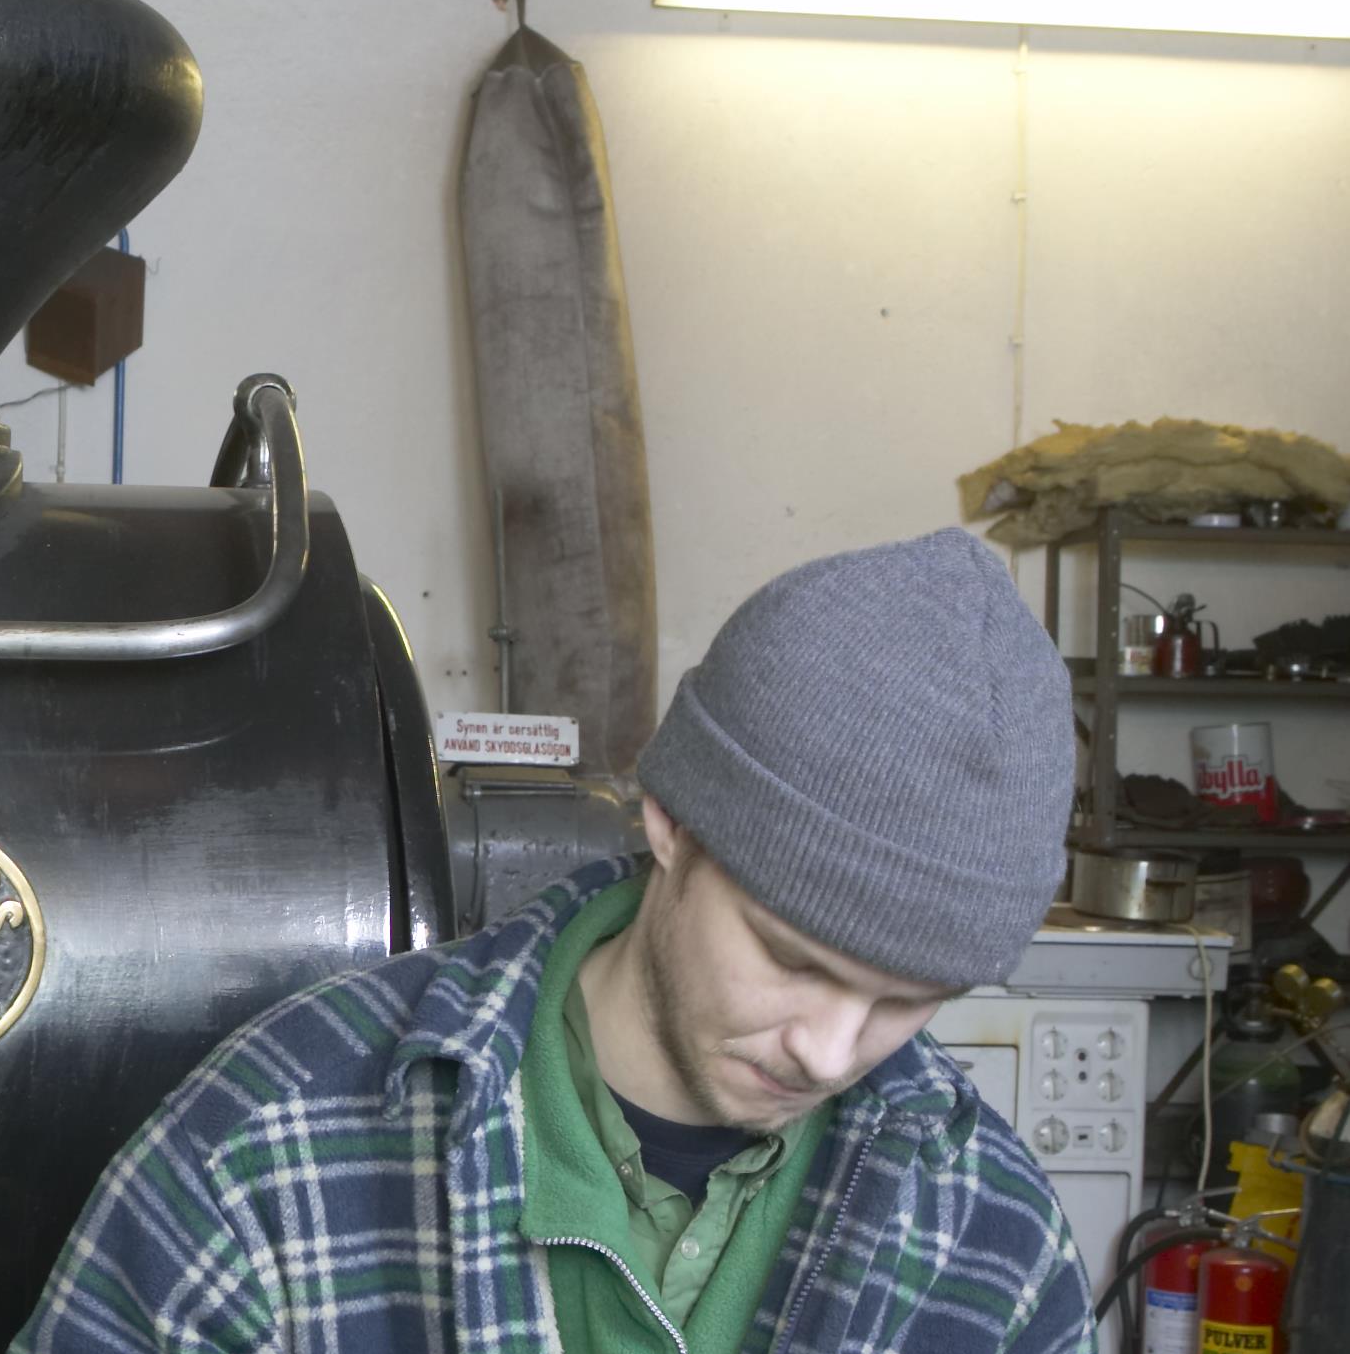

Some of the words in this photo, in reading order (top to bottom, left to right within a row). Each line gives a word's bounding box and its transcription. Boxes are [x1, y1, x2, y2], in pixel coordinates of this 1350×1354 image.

[456, 719, 488, 737] Synen
[444, 737, 480, 753] ANVÄND
[1204, 1327, 1267, 1350] PULVER
